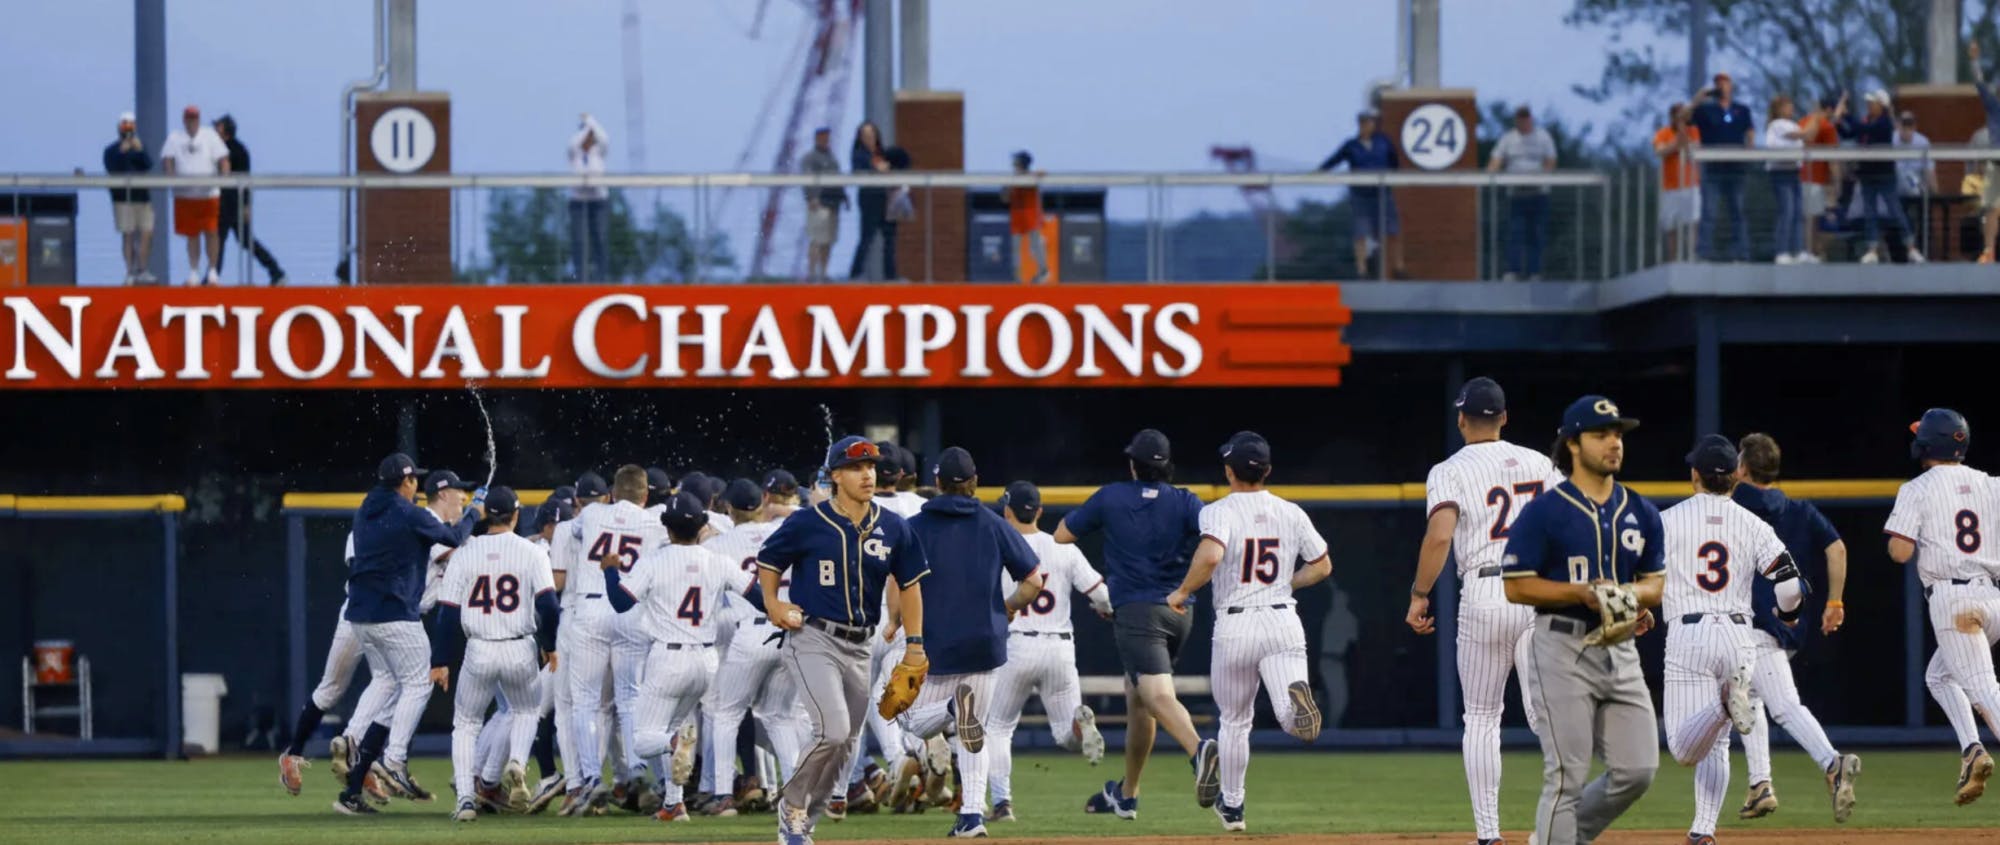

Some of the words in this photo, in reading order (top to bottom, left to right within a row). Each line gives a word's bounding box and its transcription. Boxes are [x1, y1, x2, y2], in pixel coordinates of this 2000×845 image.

[392, 120, 414, 160] 11
[1411, 117, 1457, 154] 24
[4, 296, 552, 380] NATIONAL
[571, 293, 1203, 380] CHAMPIONS
[587, 531, 643, 573] 45
[863, 538, 892, 561] GT
[1953, 509, 1981, 554] 8
[819, 559, 836, 586] 8
[1240, 538, 1280, 584] 15
[1696, 540, 1729, 593] 3
[467, 574, 520, 615] 48
[677, 586, 704, 627] 4
[1018, 572, 1056, 616] 6
